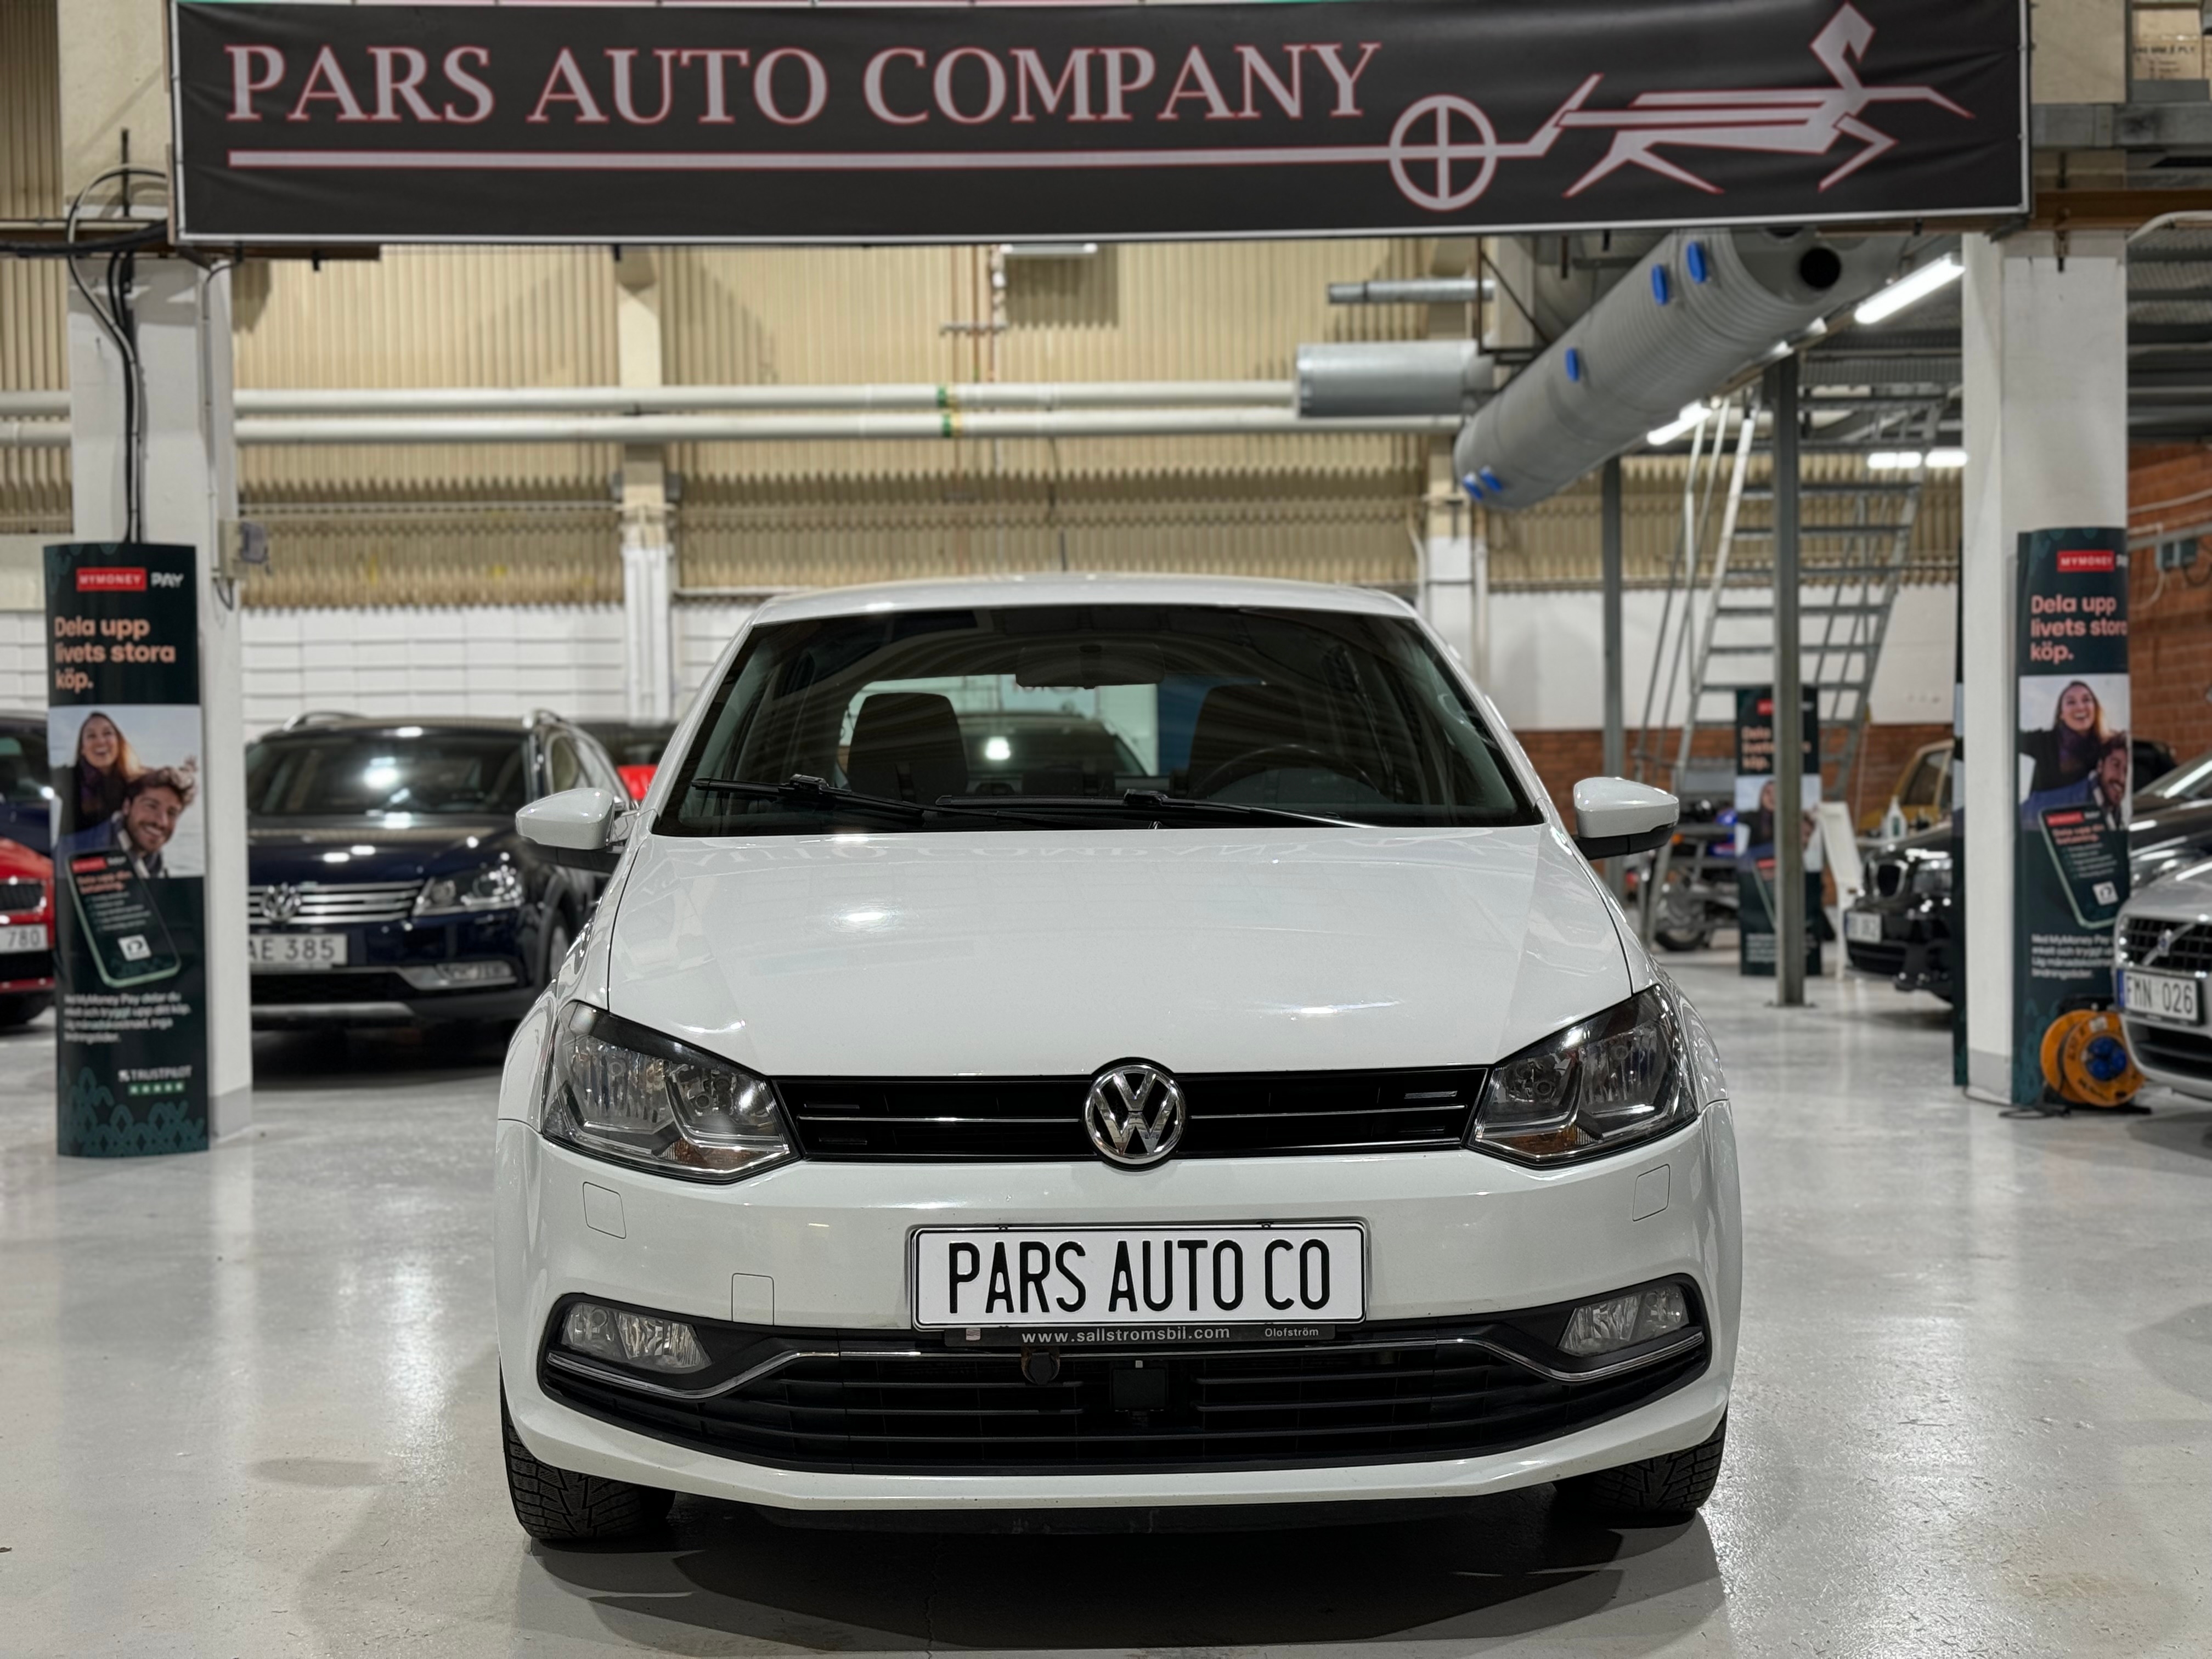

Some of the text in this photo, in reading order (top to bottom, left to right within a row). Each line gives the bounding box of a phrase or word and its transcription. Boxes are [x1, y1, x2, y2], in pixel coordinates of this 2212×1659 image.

[223, 42, 1383, 126] PARS AUTO COMPANY
[2061, 556, 2112, 566] MYMONEY
[78, 572, 184, 588] MYMONEY PAY
[2031, 594, 2117, 616] Dela upp
[55, 616, 150, 641] Dela upp
[2030, 618, 2086, 637] livets
[55, 642, 176, 663] livets stora
[2030, 641, 2074, 665] köp.
[56, 668, 94, 693] köp.
[7, 929, 40, 947] 780
[285, 939, 335, 960] 385
[121, 993, 140, 1005] Pay
[2126, 975, 2193, 1014] FMN 026
[949, 1238, 1330, 1314] PARS AUTO CO
[1022, 1325, 1319, 1344] www.sallstromsbil.com Olofström
